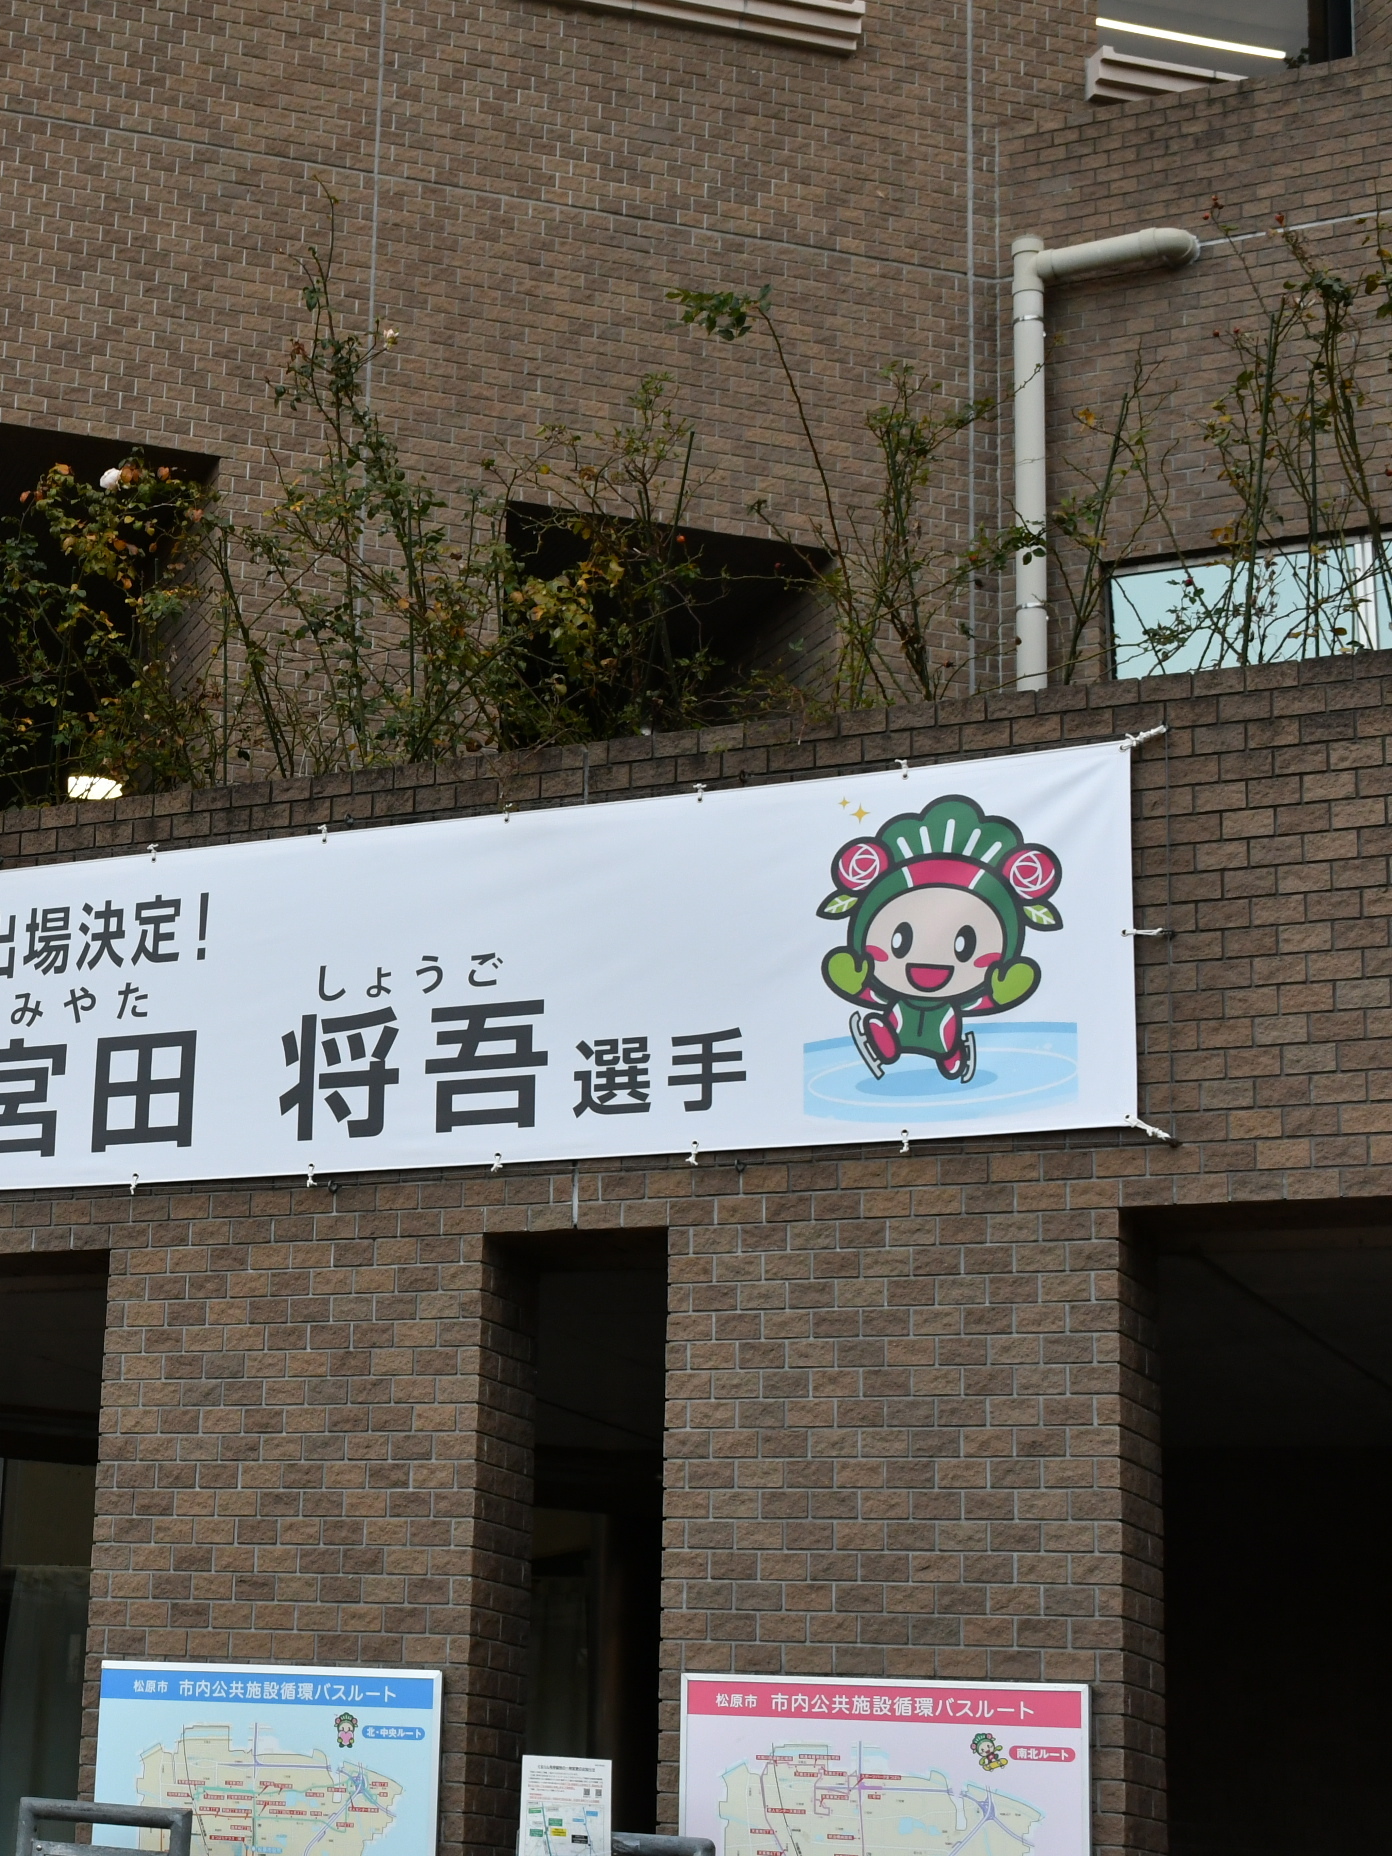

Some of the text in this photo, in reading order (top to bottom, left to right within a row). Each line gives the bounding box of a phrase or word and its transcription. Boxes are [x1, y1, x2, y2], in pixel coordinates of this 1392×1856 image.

[318, 952, 504, 1001] しょうご
[10, 982, 149, 1028] みやた
[133, 1679, 397, 1702] 松原市 市内公共施設循環バスルート
[715, 1692, 1036, 1720] 松原市 市内公共施設循環バスルート
[365, 1726, 423, 1740] 北・中央ルート
[1015, 1747, 1071, 1761] 南北ルート
